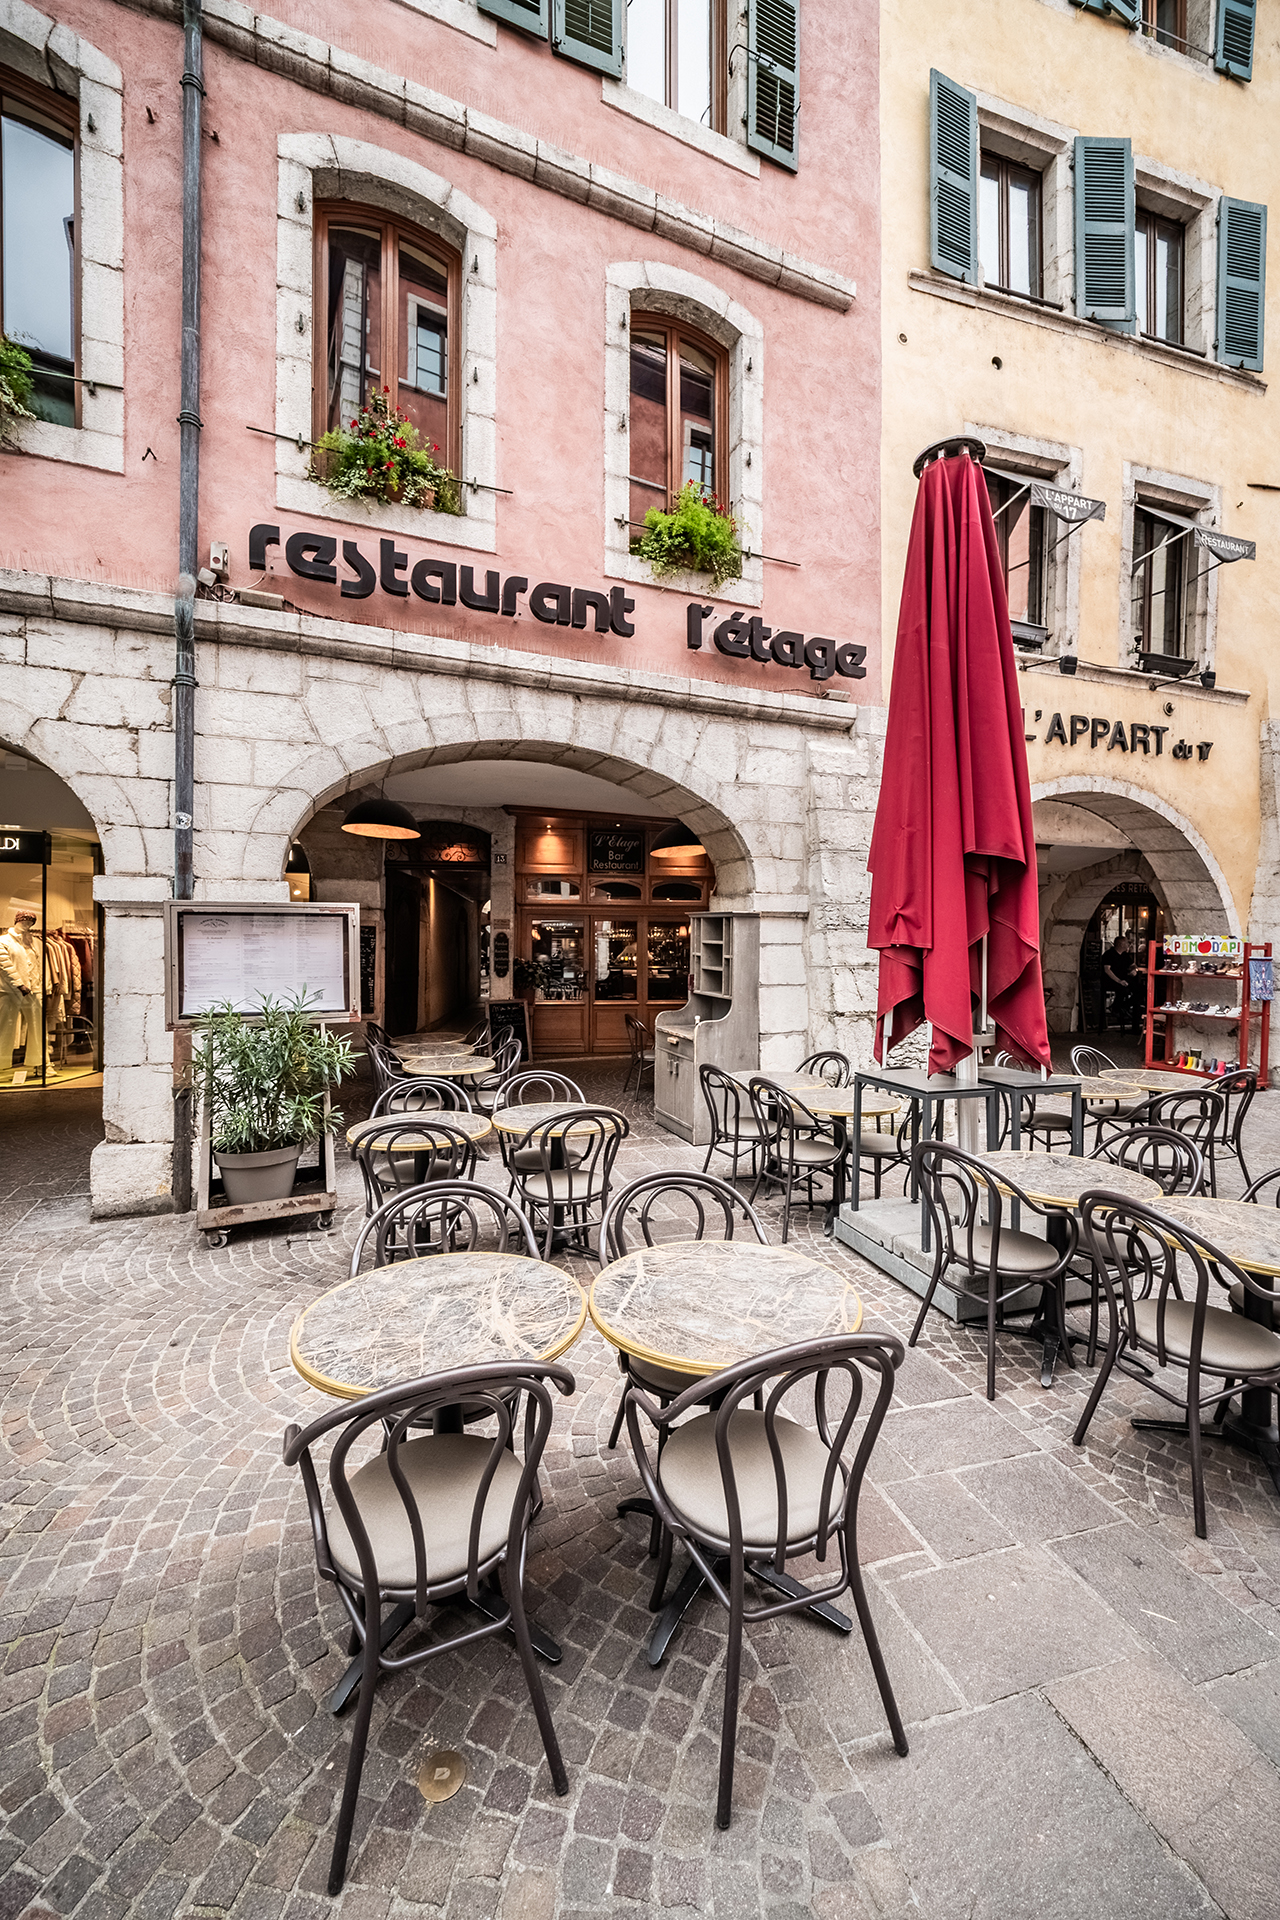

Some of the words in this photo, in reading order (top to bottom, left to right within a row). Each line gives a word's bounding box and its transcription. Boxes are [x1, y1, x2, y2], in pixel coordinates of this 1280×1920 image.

[1045, 489, 1093, 510] L'APPART
[1063, 505, 1077, 520] 17
[1202, 534, 1249, 554] RESTAURANT
[249, 523, 635, 638] restaurant
[687, 602, 867, 680] l'étage
[1172, 739, 1193, 760] du
[1196, 741, 1214, 761] 17
[593, 859, 639, 869] Restaurant
[608, 850, 625, 860] Bar
